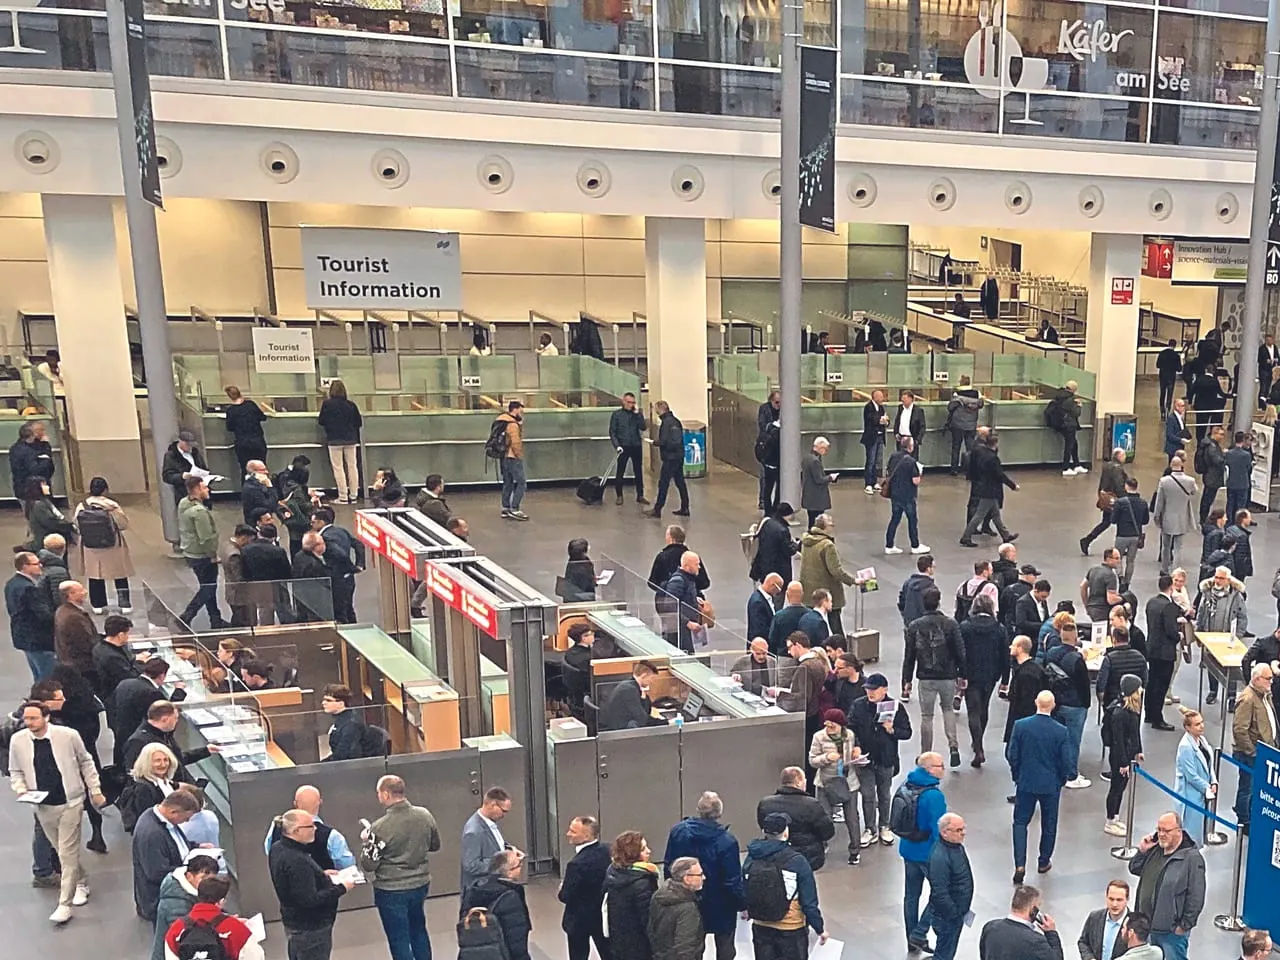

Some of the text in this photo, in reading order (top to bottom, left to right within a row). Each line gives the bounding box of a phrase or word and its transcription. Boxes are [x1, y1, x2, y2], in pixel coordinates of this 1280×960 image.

[1057, 19, 1135, 63] Käfer
[1116, 73, 1191, 91] am See
[1178, 243, 1212, 253] Innovation
[1213, 245, 1227, 254] Hub
[317, 255, 390, 273] Tourist
[320, 280, 441, 299] Information
[267, 343, 300, 352] Tourist
[258, 354, 311, 362] Information
[1259, 789, 1275, 805] bitte
[1261, 806, 1280, 822] please
